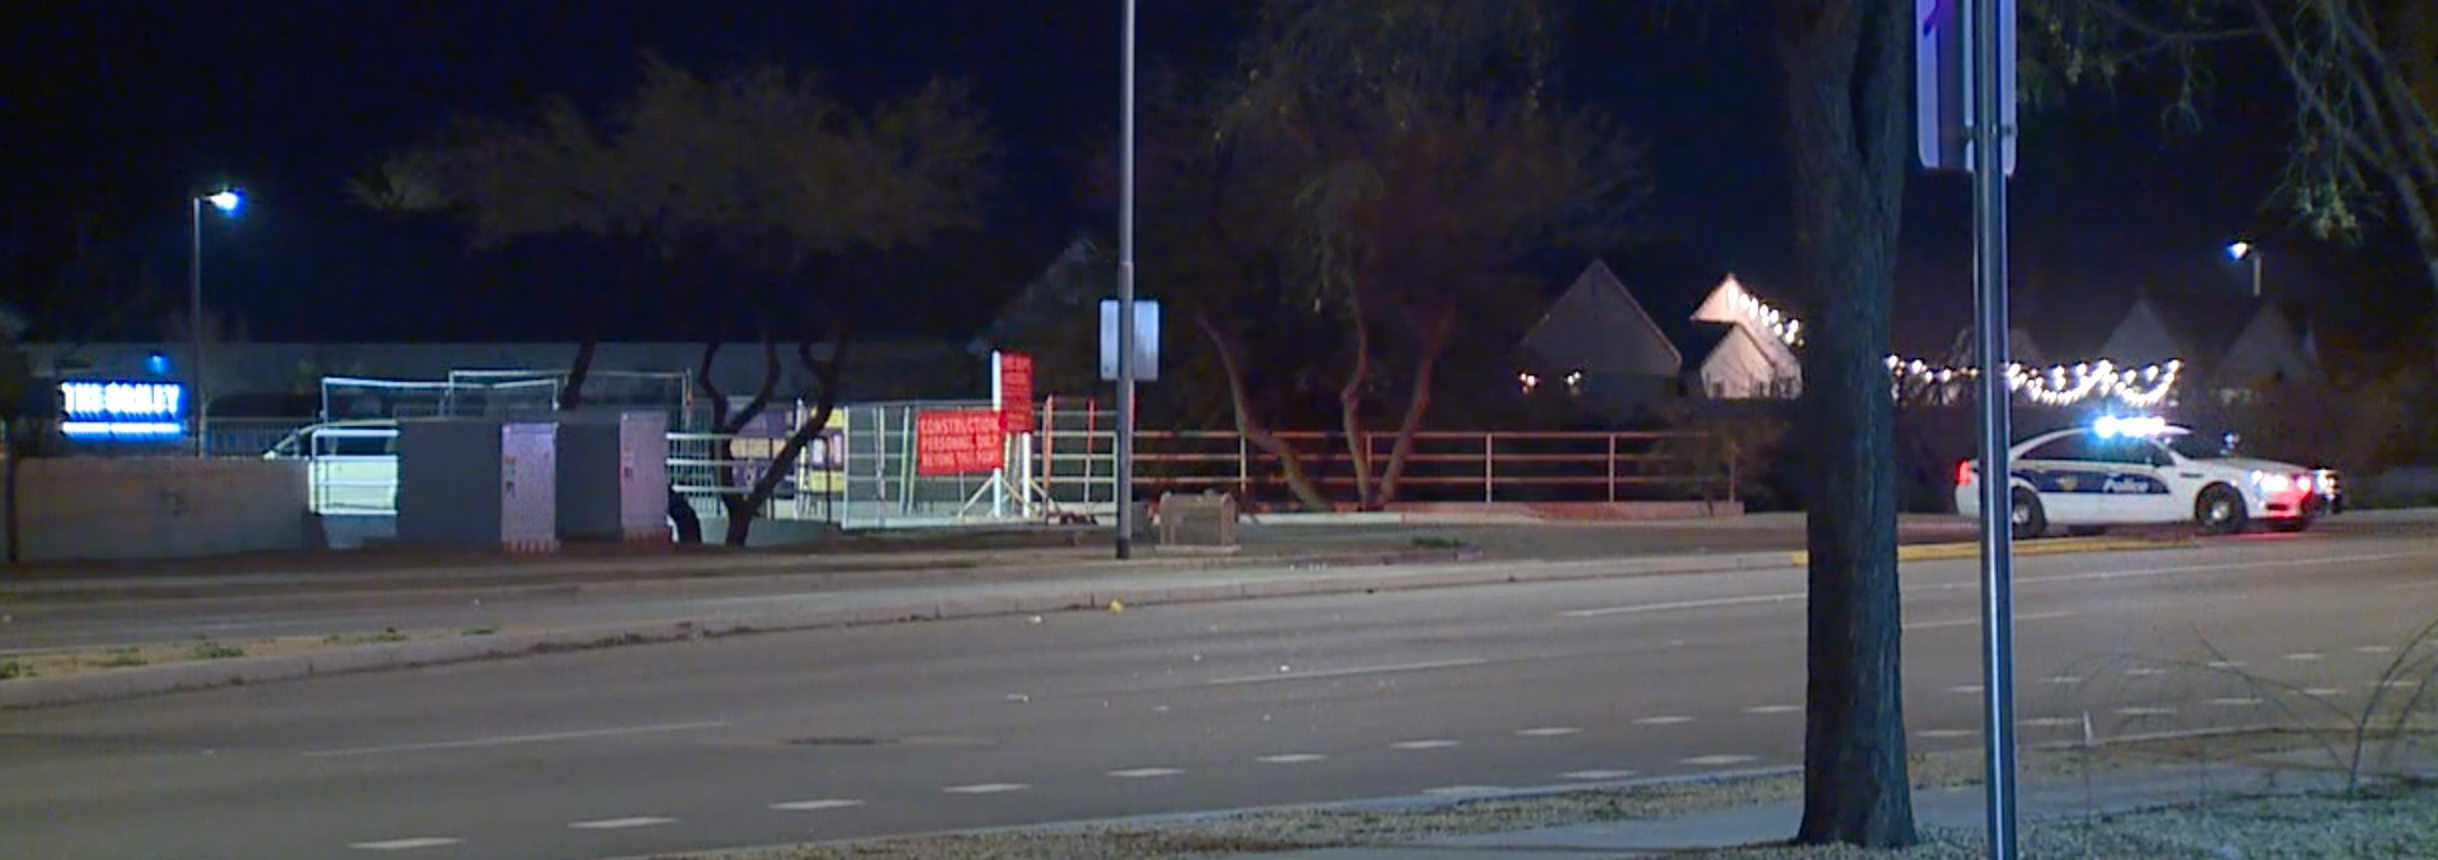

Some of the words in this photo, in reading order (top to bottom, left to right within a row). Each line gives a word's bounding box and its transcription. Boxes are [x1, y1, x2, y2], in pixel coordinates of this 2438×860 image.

[920, 417, 1000, 434] CONSTRUCTION
[921, 435, 973, 451] PERSONNEL
[976, 434, 1000, 450] ONLY
[2102, 472, 2149, 493] Police
